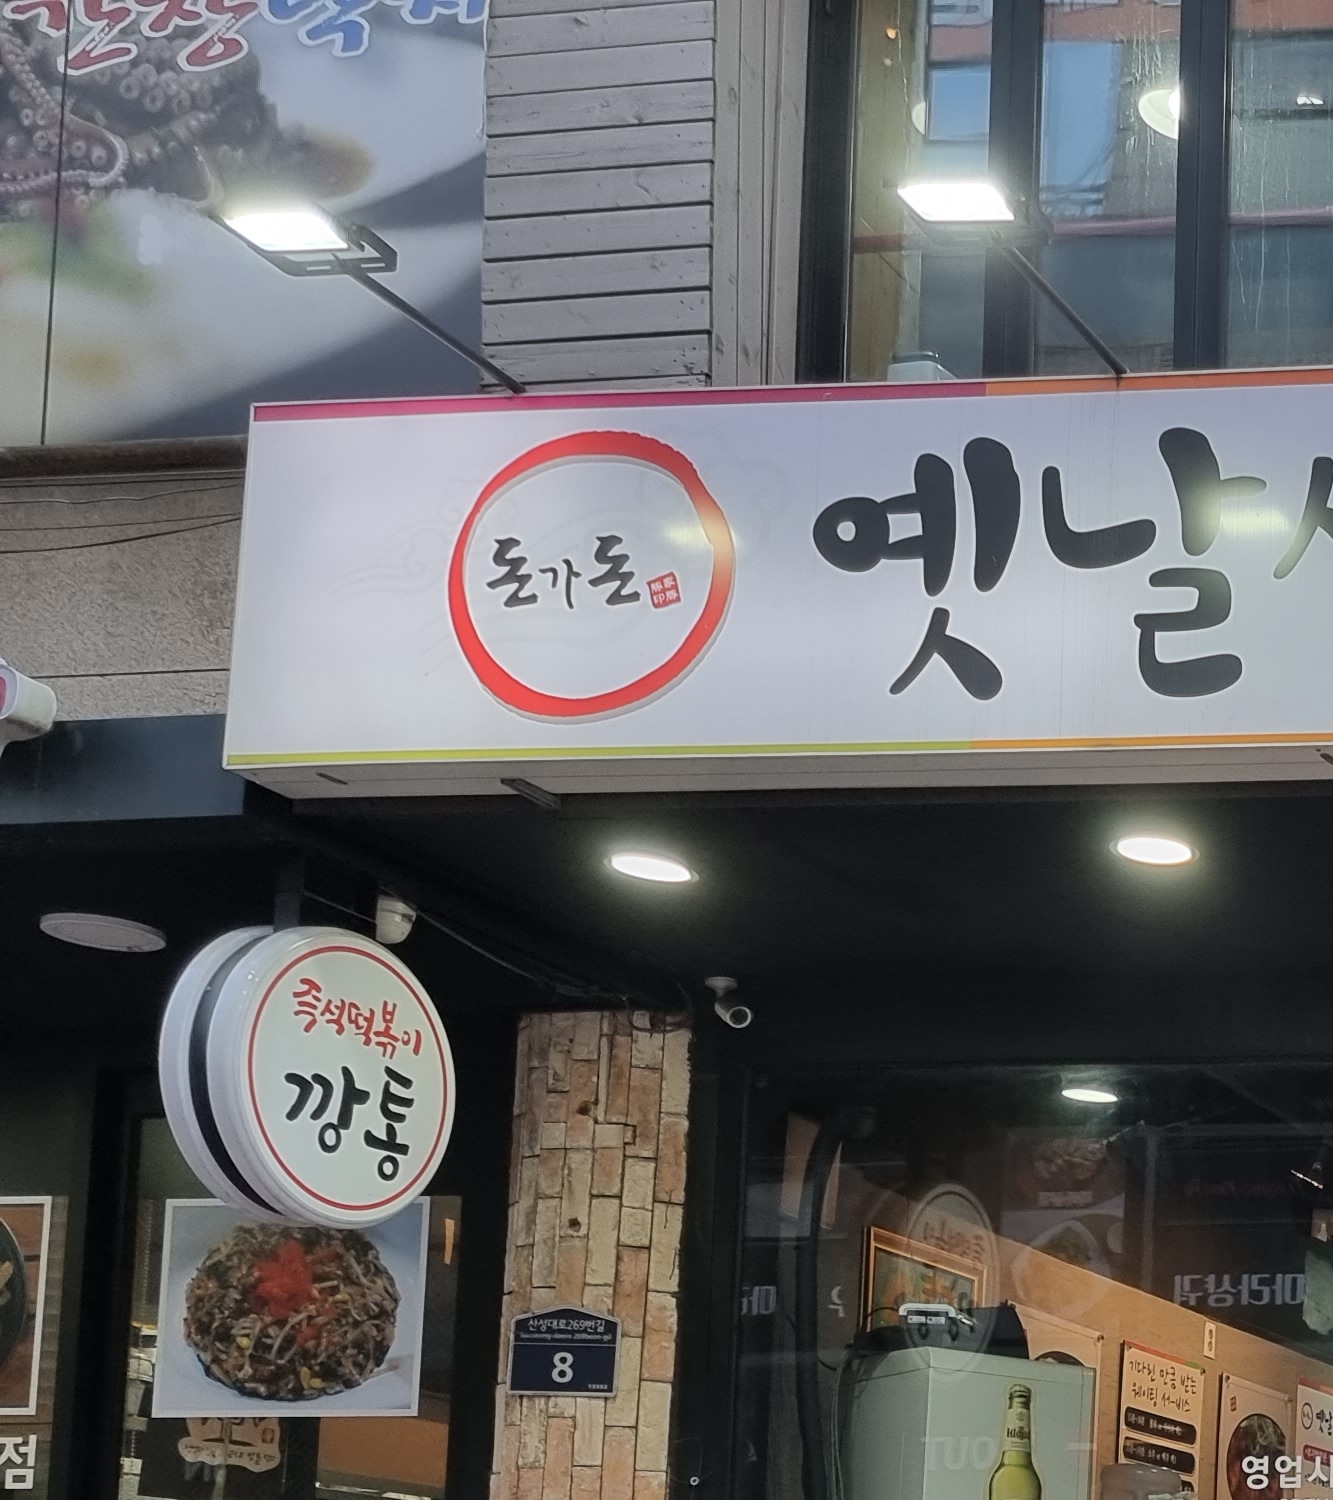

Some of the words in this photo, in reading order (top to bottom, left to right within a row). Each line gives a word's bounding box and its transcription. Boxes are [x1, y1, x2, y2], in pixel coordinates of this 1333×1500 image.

[486, 535, 641, 608] 돈가돈
[293, 977, 422, 1057] 즉석떡볶이
[284, 1066, 415, 1182] 깡통
[528, 1319, 605, 1332] 산성대로269번길
[551, 1352, 574, 1383] 8
[1129, 1360, 1155, 1382] 기다린
[1160, 1366, 1177, 1390] 만큼
[1180, 1374, 1197, 1395] 받는
